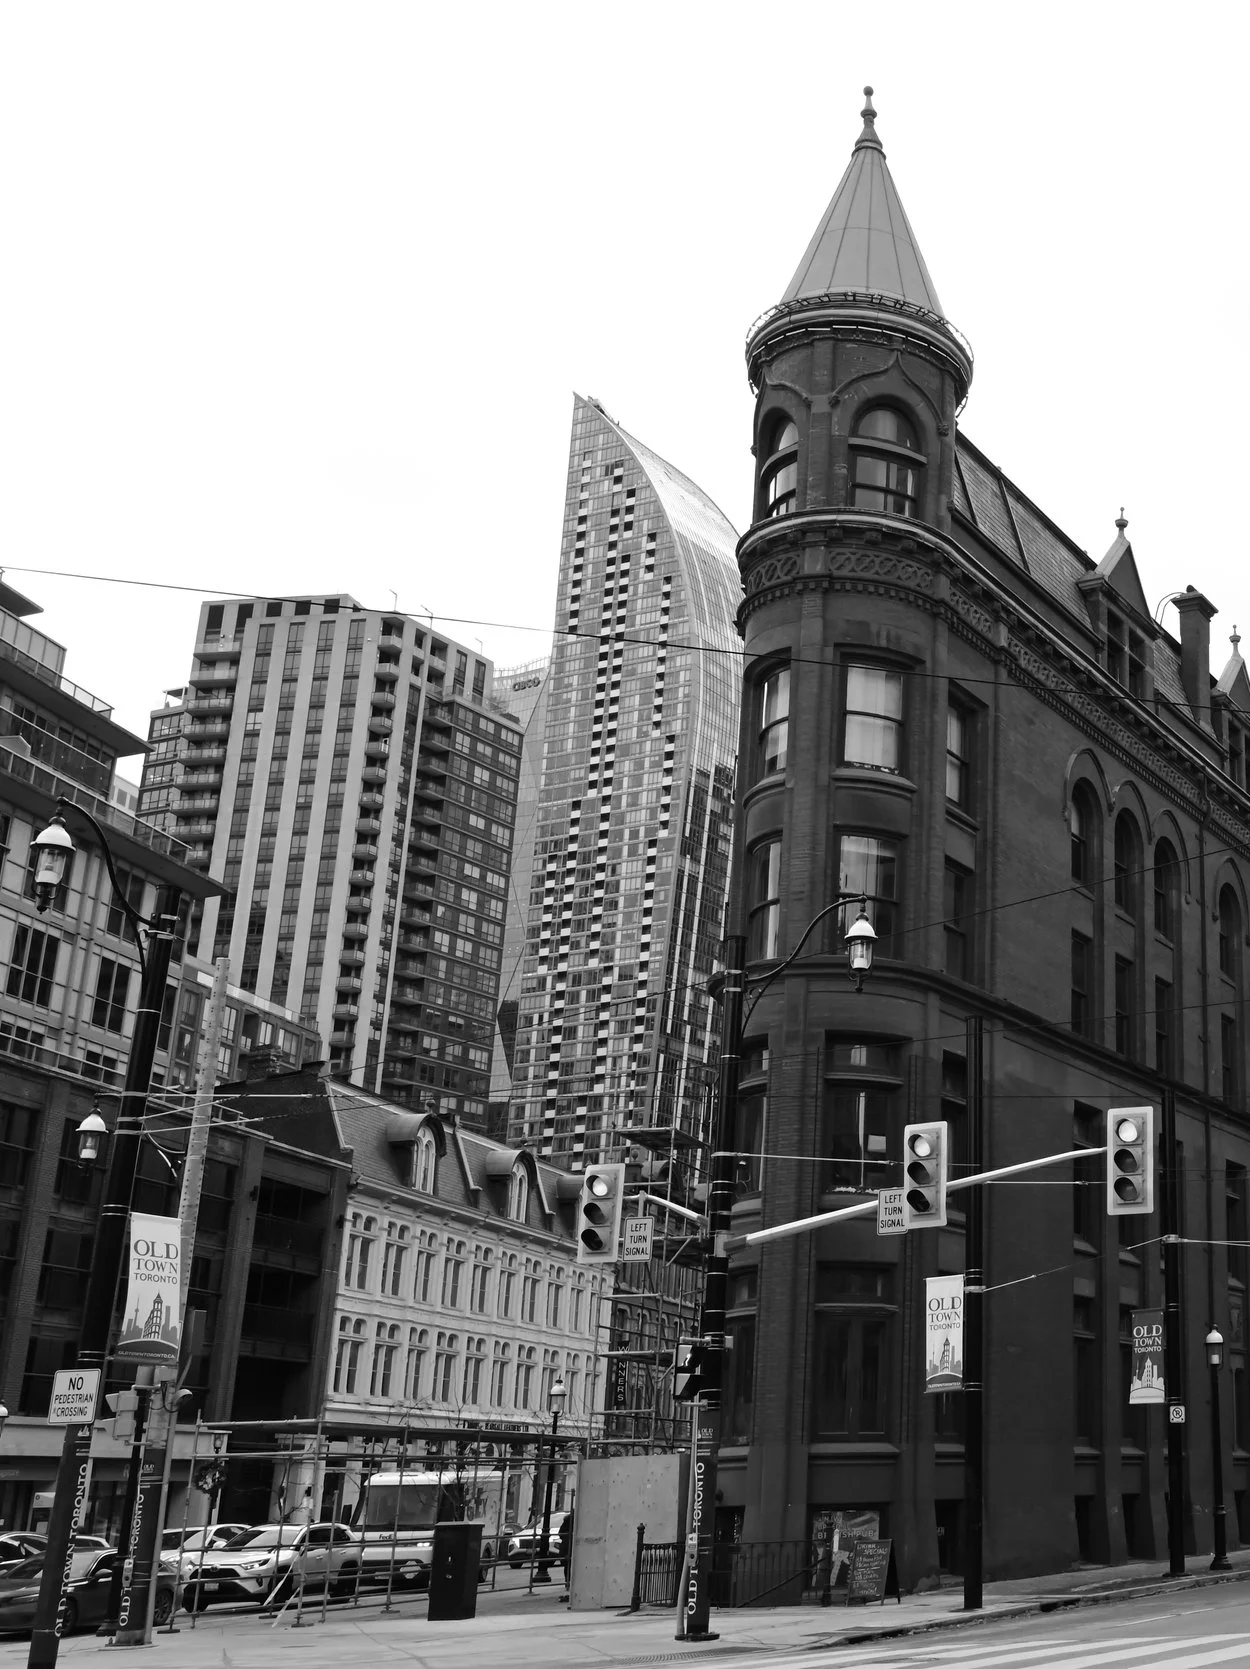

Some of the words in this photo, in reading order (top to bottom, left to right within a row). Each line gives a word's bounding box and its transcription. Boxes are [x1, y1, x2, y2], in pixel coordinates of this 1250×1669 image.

[884, 1194, 902, 1204] LEFT
[884, 1207, 902, 1216] TURN
[630, 1223, 647, 1232] LEFT
[880, 1220, 905, 1228] SIGNAL
[630, 1235, 648, 1244] TURN
[133, 1239, 178, 1260] OLD
[625, 1246, 648, 1256] SIGNAL
[133, 1258, 178, 1274] TOWN
[134, 1272, 178, 1284] TORONTO
[928, 1296, 962, 1312] OLD
[928, 1312, 961, 1323] TOWN
[1133, 1324, 1162, 1337] OLD
[1134, 1337, 1162, 1347] TOWN
[618, 1346, 629, 1402] WNNERS
[68, 1376, 84, 1390] NO
[54, 1393, 94, 1404] PEDESTRIAN
[57, 1406, 87, 1417] CROSSING
[61, 1544, 75, 1594] TOWN
[69, 1464, 88, 1538] TORONTO
[688, 1580, 698, 1614] OLD
[119, 1597, 131, 1626] OLD
